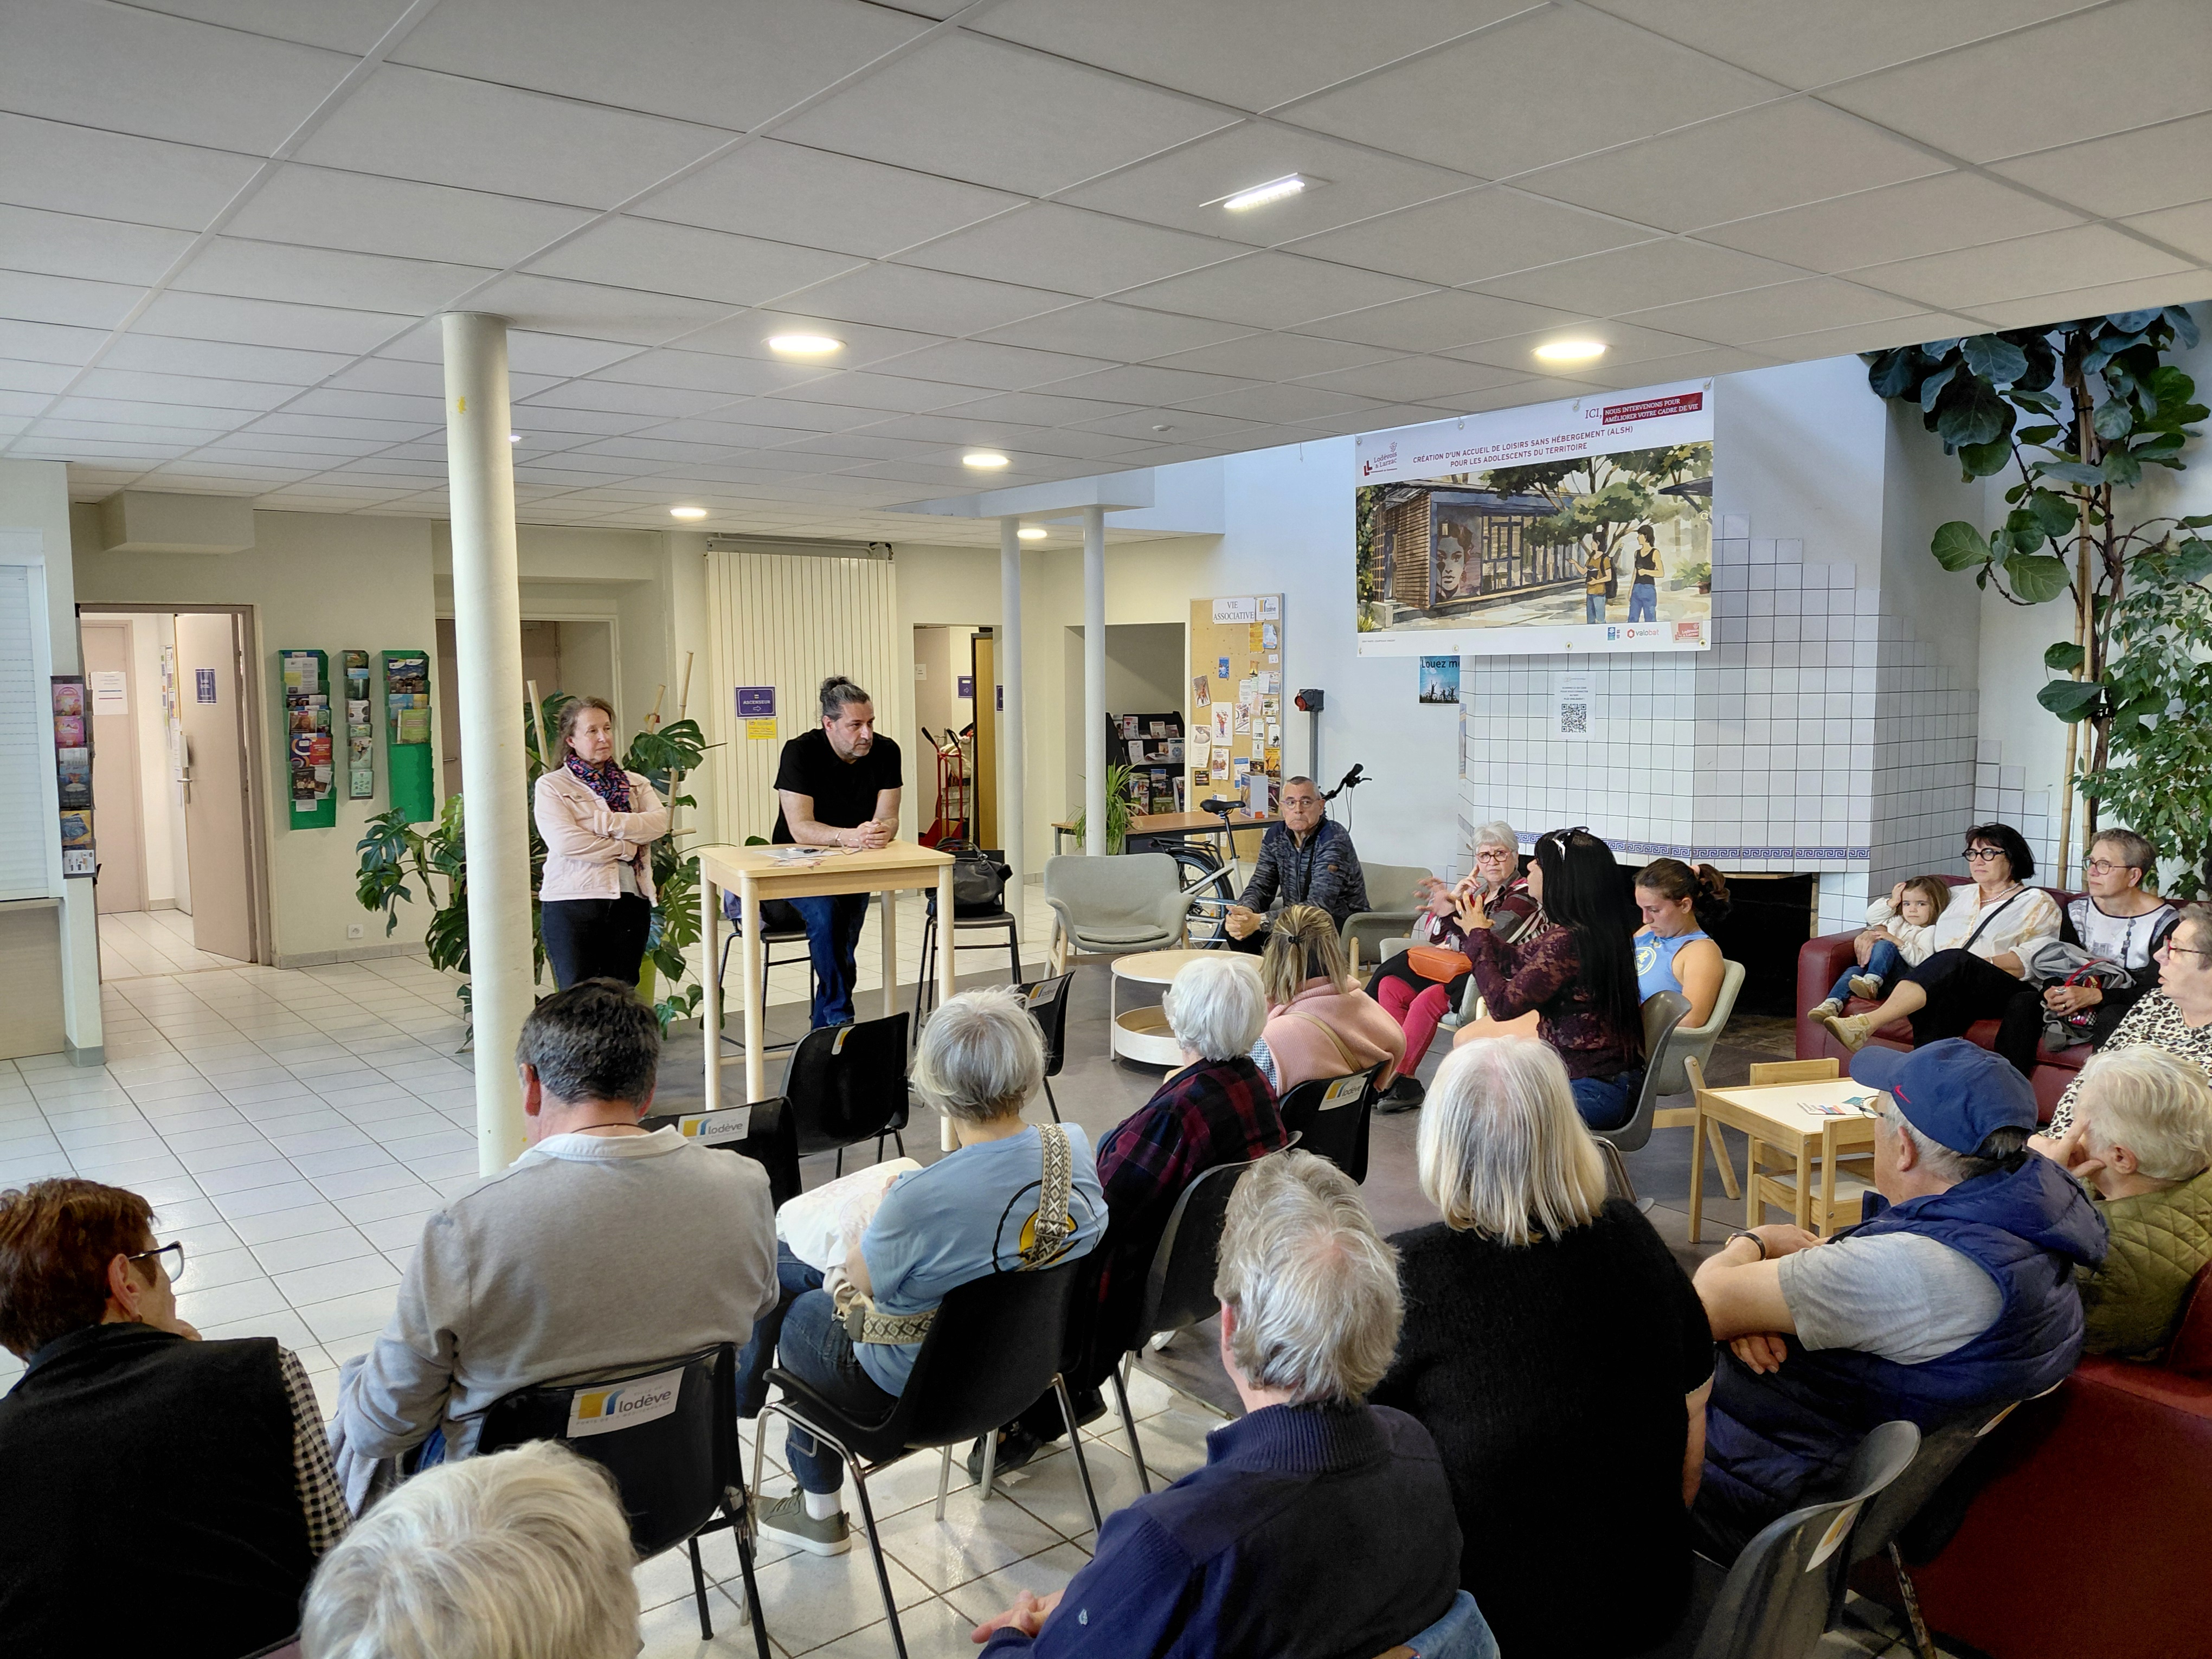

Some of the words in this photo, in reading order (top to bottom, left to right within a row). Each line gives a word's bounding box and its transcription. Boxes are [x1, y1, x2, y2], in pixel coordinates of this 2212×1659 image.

[1585, 408, 1603, 419] ICI,
[1622, 401, 1663, 413] INTERVENONS
[1664, 398, 1681, 406] POUR
[1604, 413, 1637, 423] AMÉLIORER
[1638, 410, 1657, 418] VOTRE
[1657, 407, 1677, 415] CADRE
[1413, 453, 1444, 463] CRÉATION
[1445, 451, 1461, 459] D'UN
[1462, 446, 1490, 456] ACCUEIL
[1502, 440, 1529, 451] LOISIRS
[1531, 438, 1549, 447] SANS
[1551, 429, 1605, 443] HÉBERGEMENT
[1607, 426, 1634, 436] (ALSH)
[1374, 452, 1397, 463] Lodévois
[1450, 459, 1468, 467] POUR
[1470, 457, 1482, 465] LES
[1483, 451, 1532, 463] ADOLESCENTS
[1545, 442, 1587, 454] TERRITOIRE
[1379, 458, 1397, 467] Larzac
[1227, 601, 1238, 609] VIE
[1213, 611, 1255, 620] ASSOCIATIVE
[1422, 659, 1446, 668] Louez
[708, 1123, 743, 1135] lodève
[619, 1390, 671, 1413] lodève
